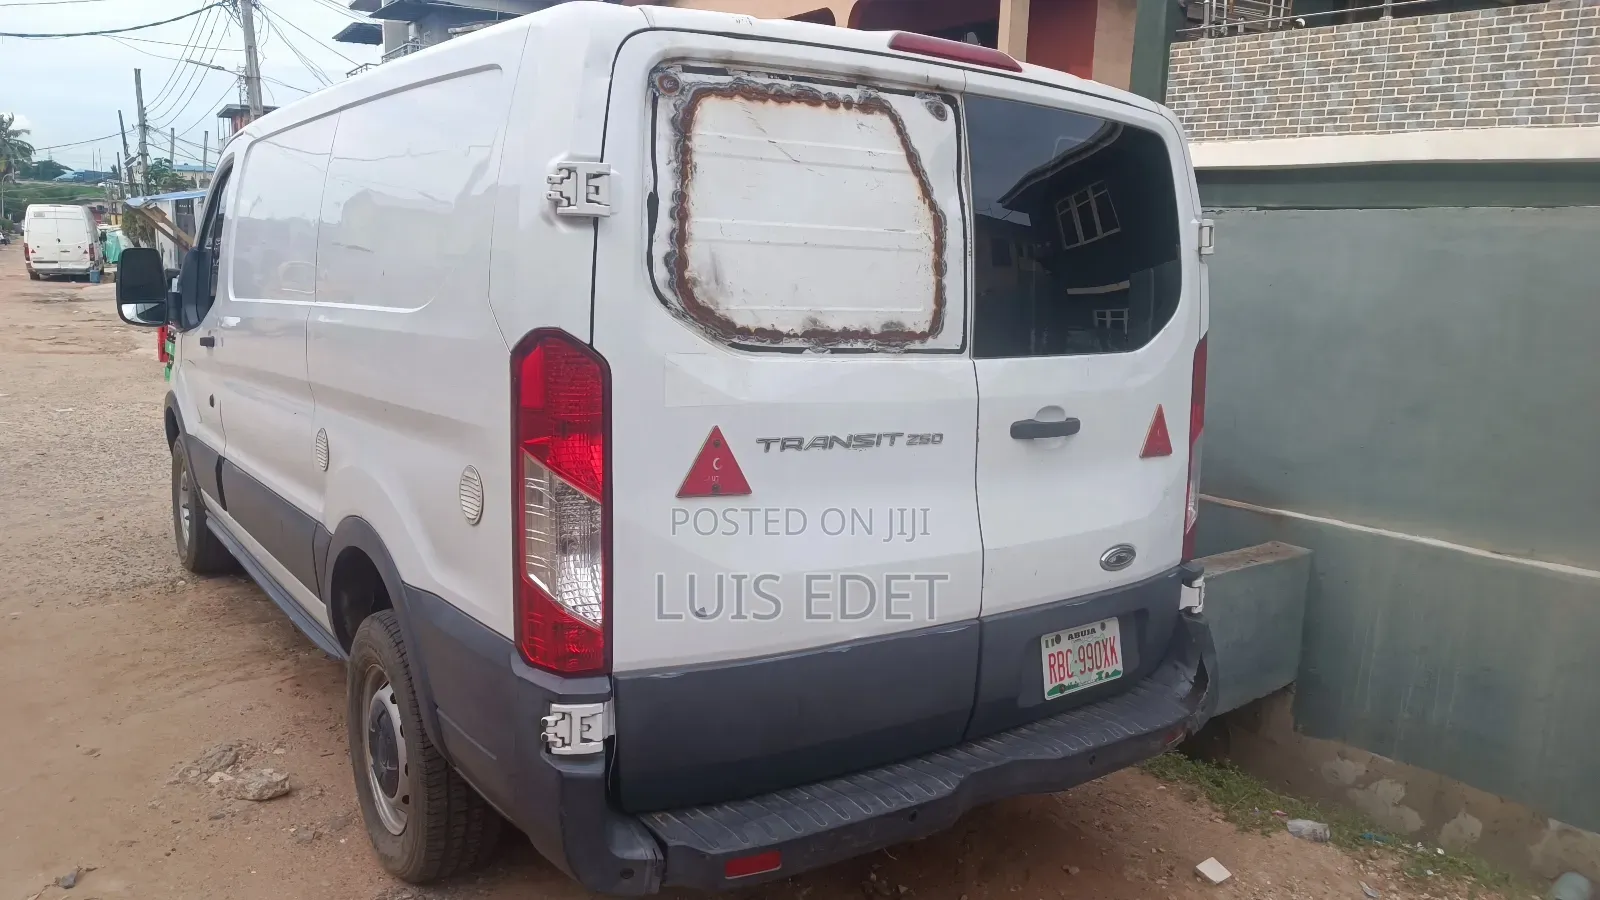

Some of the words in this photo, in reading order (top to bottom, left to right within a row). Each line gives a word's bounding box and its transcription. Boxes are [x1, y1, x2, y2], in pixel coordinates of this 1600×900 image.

[756, 432, 904, 453] TRANSIT
[906, 433, 944, 446] 250
[1067, 628, 1096, 640] ABUJA
